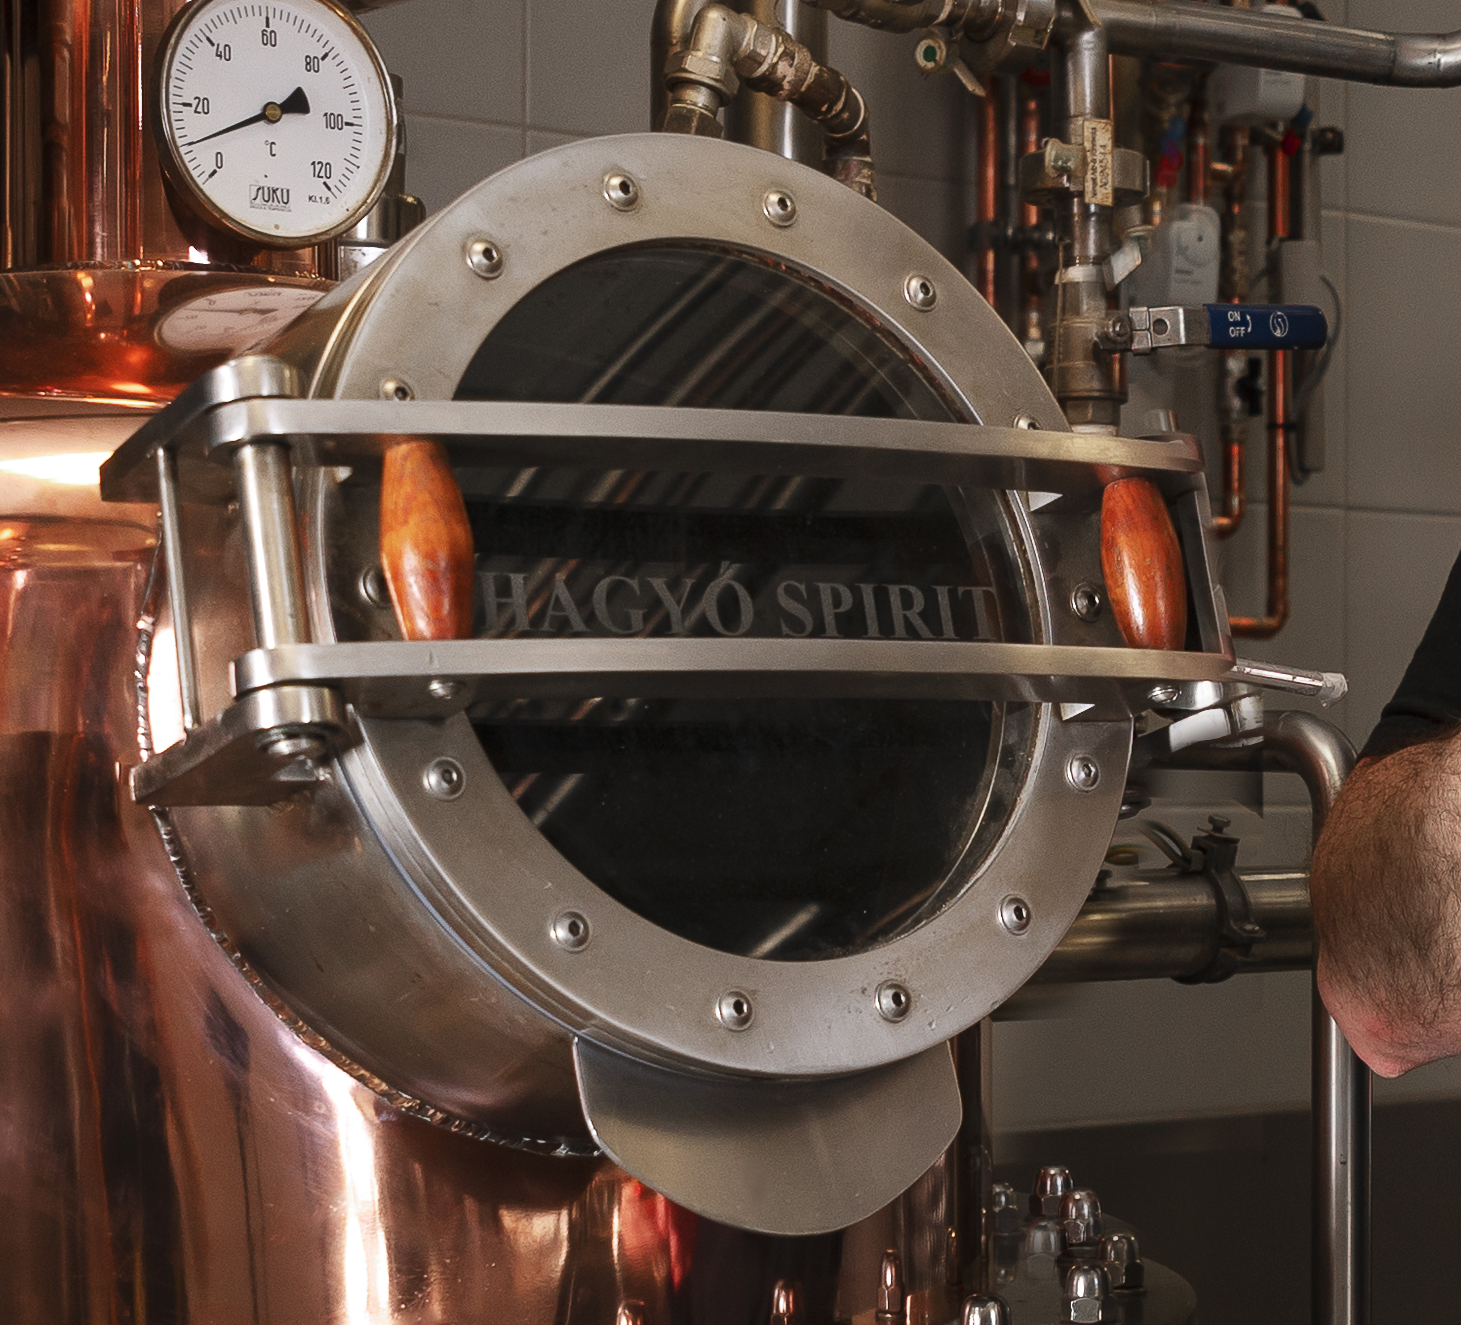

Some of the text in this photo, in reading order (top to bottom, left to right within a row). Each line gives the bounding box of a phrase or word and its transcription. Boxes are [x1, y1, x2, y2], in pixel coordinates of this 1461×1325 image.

[261, 29, 278, 48] 60
[215, 43, 232, 62] 40
[304, 54, 320, 73] 80
[193, 96, 210, 115] 20
[323, 112, 344, 131] 100
[215, 151, 224, 170] 0
[310, 160, 333, 180] 120
[251, 186, 290, 205] SUKU
[1227, 310, 1241, 322] ON
[1229, 326, 1246, 338] OFF
[481, 561, 999, 641] HAGYÓ SPIRIT
